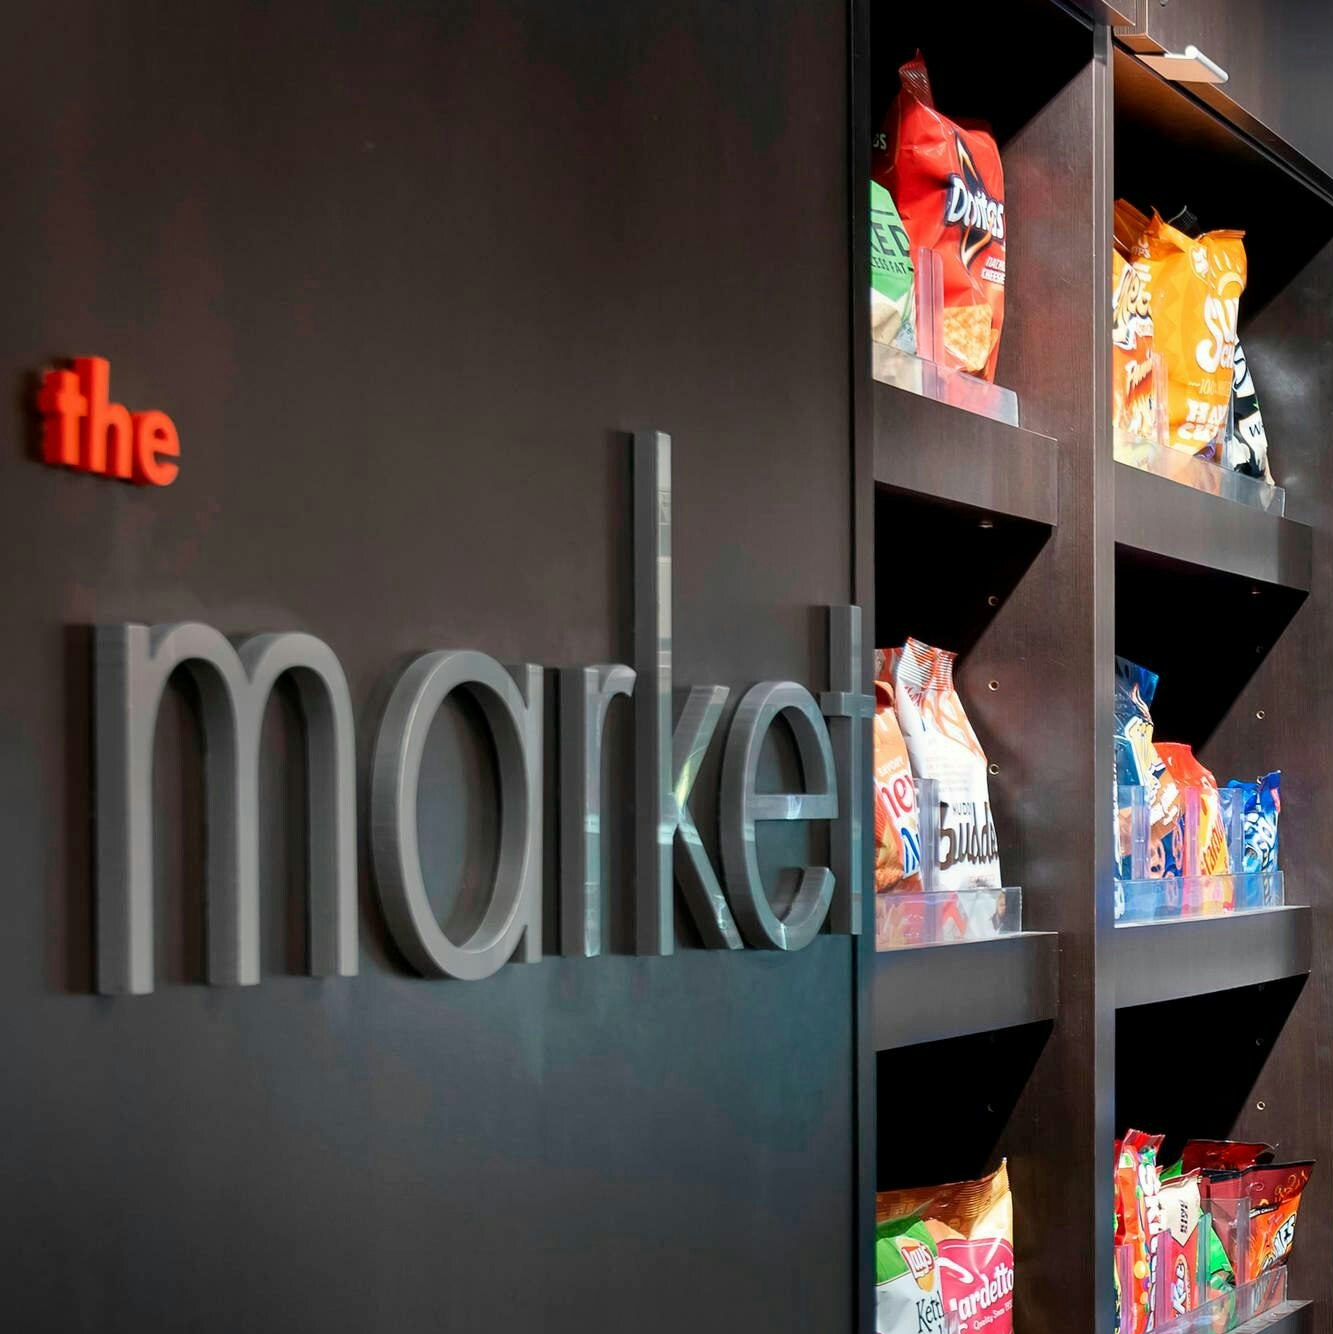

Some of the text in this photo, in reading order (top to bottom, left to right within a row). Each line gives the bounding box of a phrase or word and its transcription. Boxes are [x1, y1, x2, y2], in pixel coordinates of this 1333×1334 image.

[948, 178, 1004, 240] Doritos
[39, 356, 181, 487] the
[94, 430, 876, 997] market
[901, 1244, 933, 1279] Lay's
[915, 1290, 944, 1334] Kettl
